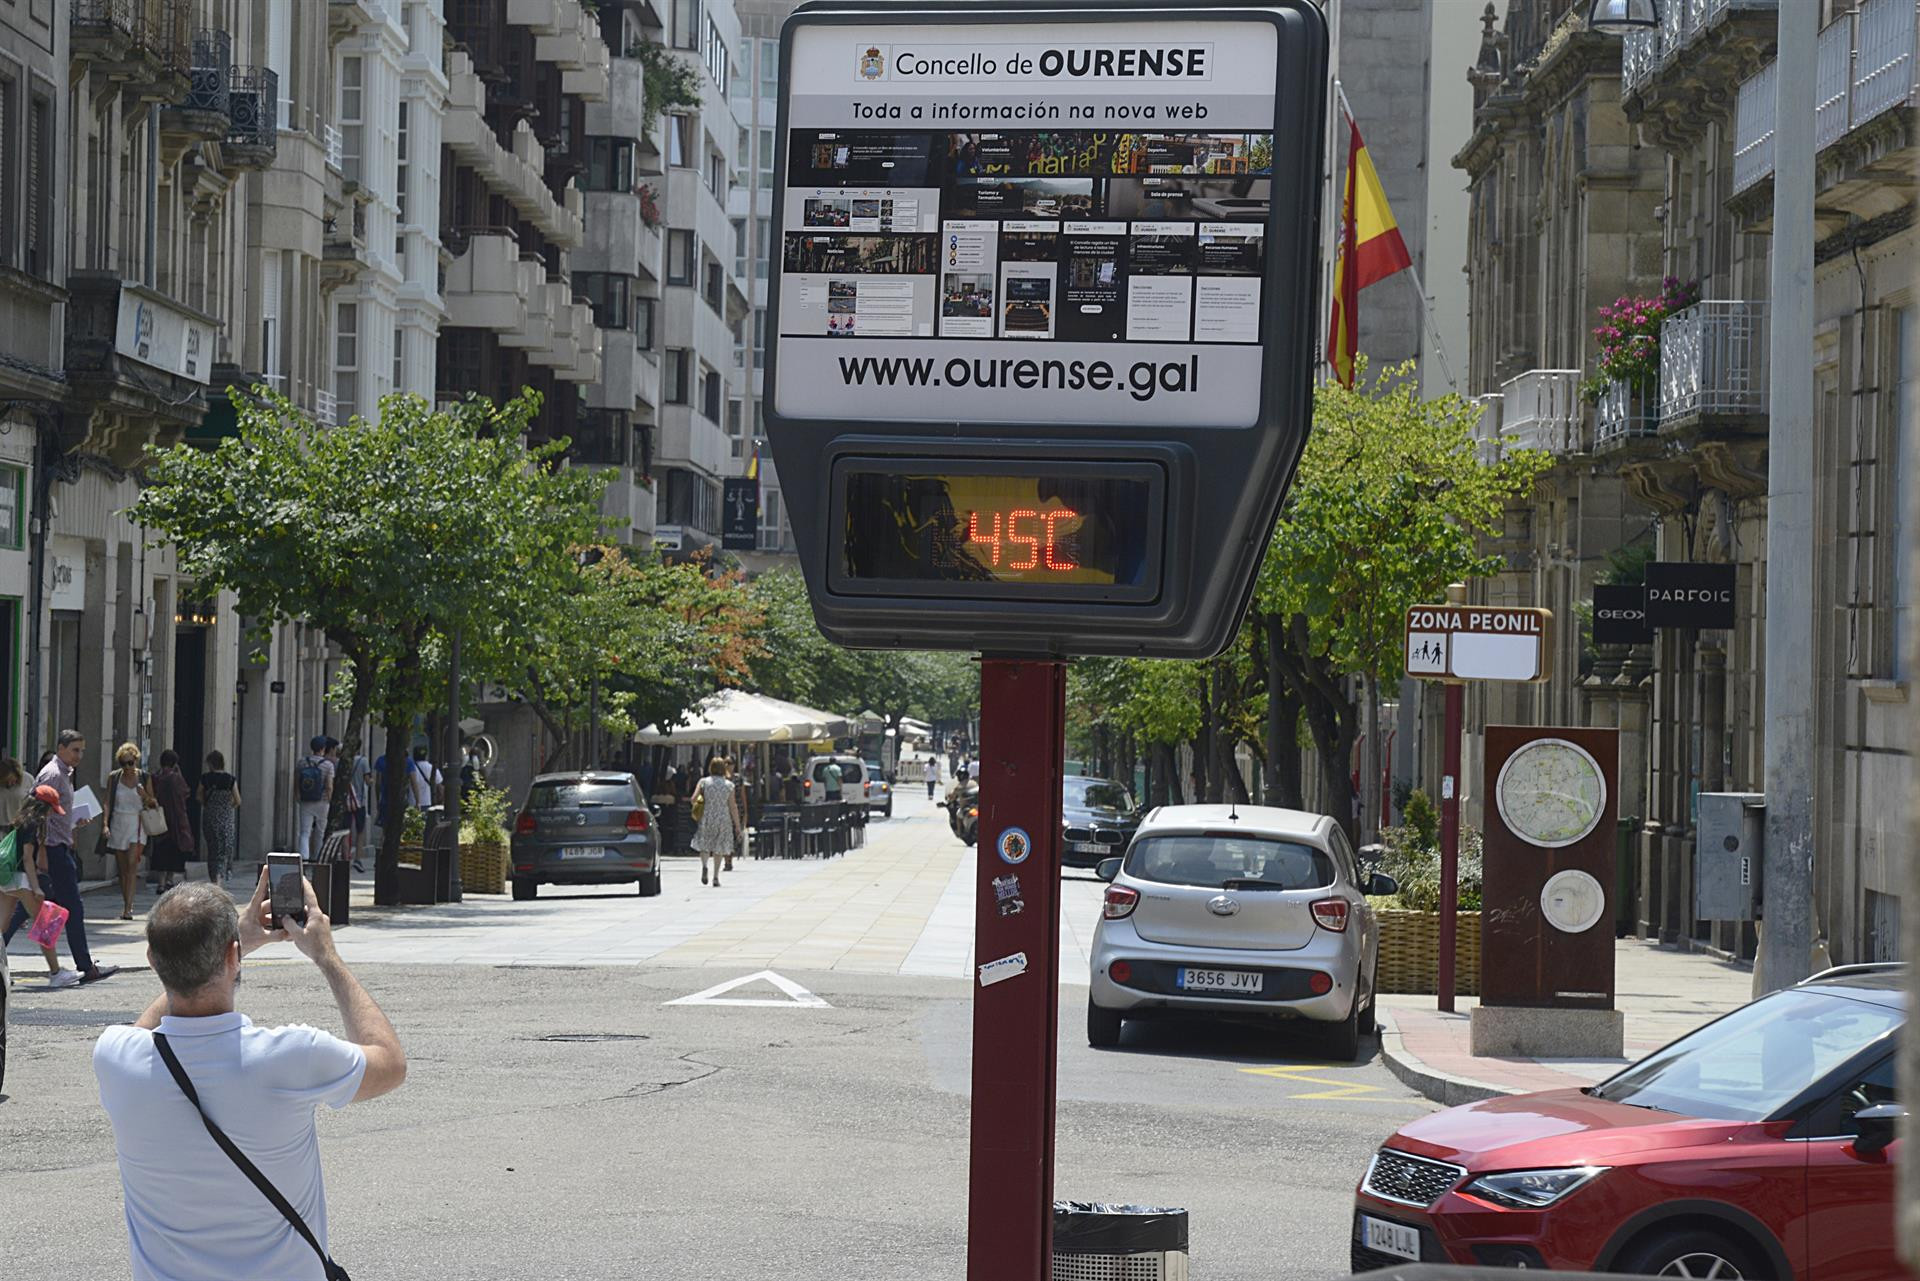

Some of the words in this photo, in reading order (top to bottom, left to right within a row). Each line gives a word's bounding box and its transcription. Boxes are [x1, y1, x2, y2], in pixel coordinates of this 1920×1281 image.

[896, 53, 997, 75] Concello
[1006, 53, 1033, 74] de
[1039, 49, 1205, 76] OURENSE
[853, 102, 901, 119] Toda
[911, 106, 923, 119] a
[932, 101, 1059, 118] información
[1069, 106, 1095, 118] na
[1105, 106, 1156, 118] nova
[1165, 103, 1208, 118] web
[838, 354, 1199, 401] www.ourense.gal
[1410, 611, 1462, 629] ZONA
[1469, 613, 1540, 631] PEONIL
[1187, 971, 1225, 986] 3656
[1231, 974, 1259, 988] JVV
